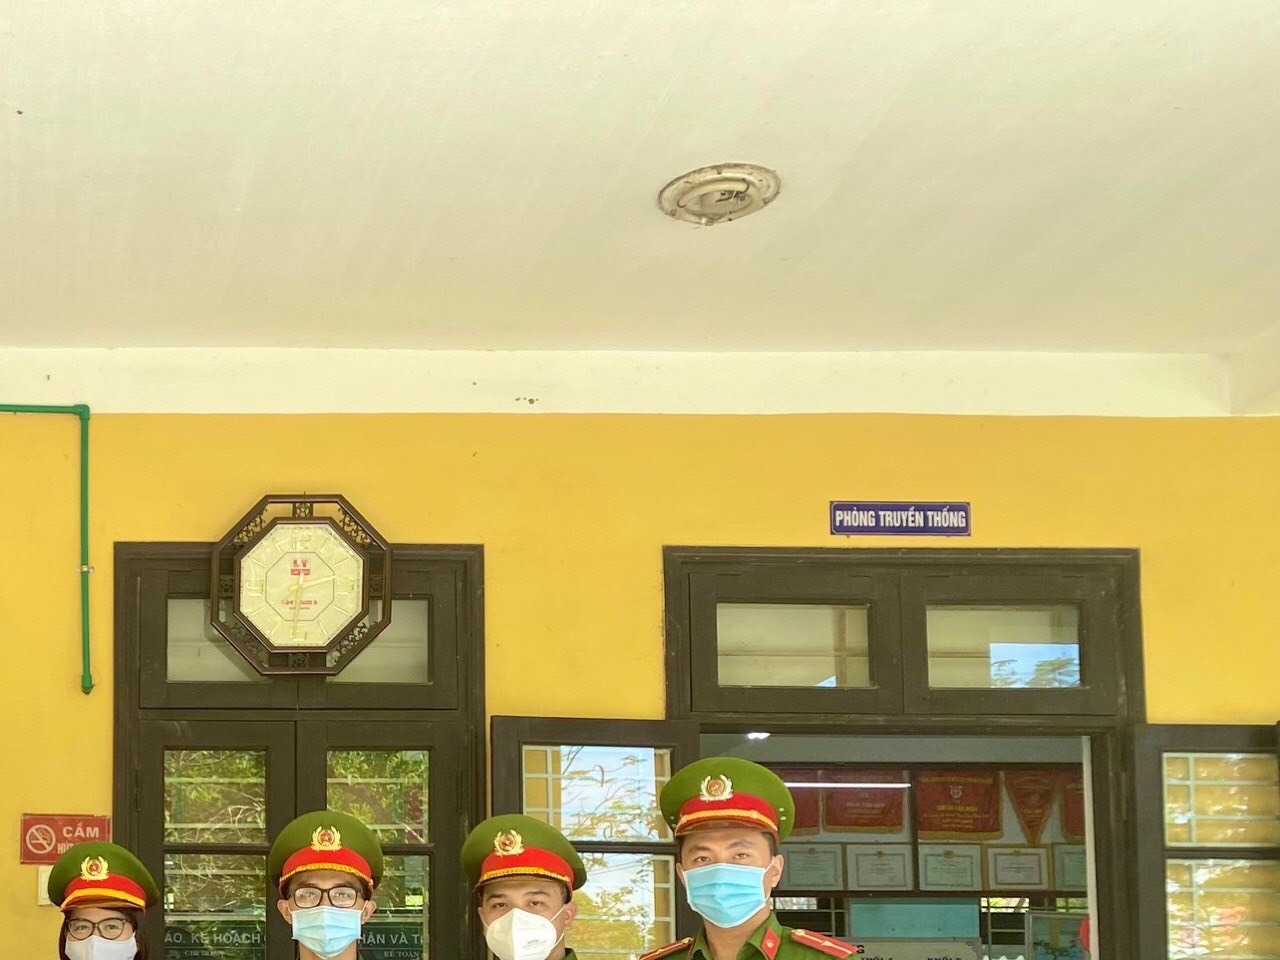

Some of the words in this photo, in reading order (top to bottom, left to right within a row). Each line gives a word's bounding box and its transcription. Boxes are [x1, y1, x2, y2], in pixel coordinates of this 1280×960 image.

[835, 507, 876, 527] PHÒNG
[927, 505, 966, 527] THỐNG
[62, 822, 99, 838] CẤM
[390, 932, 408, 944] VÀ
